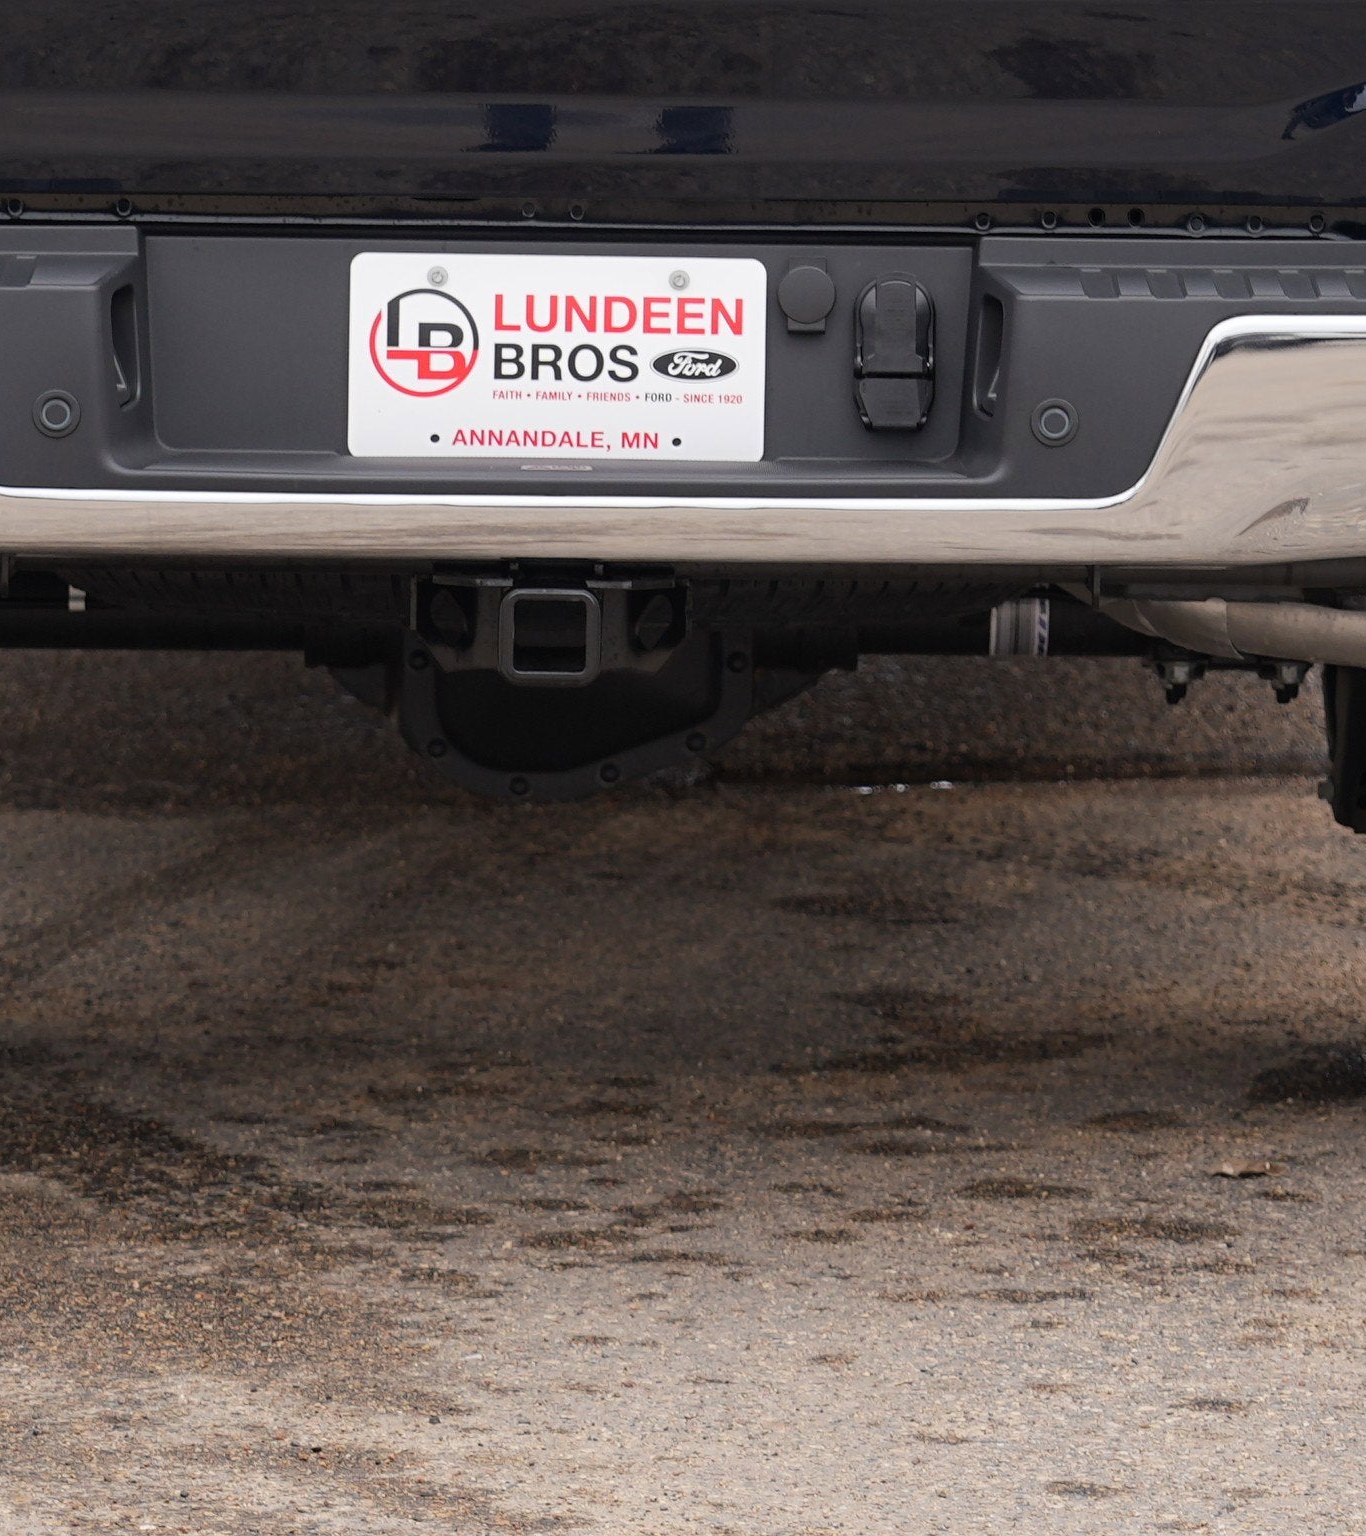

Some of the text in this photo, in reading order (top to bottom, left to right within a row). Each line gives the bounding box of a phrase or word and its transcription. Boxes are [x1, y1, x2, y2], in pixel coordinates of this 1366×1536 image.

[493, 293, 744, 336] LUNDEEN
[493, 341, 640, 383] BROS
[666, 350, 724, 379] Ford
[492, 389, 744, 405] FAITH FAMILY FRIENDS FORD SINCE 1920
[451, 428, 660, 452] ANNANDALE, MN
